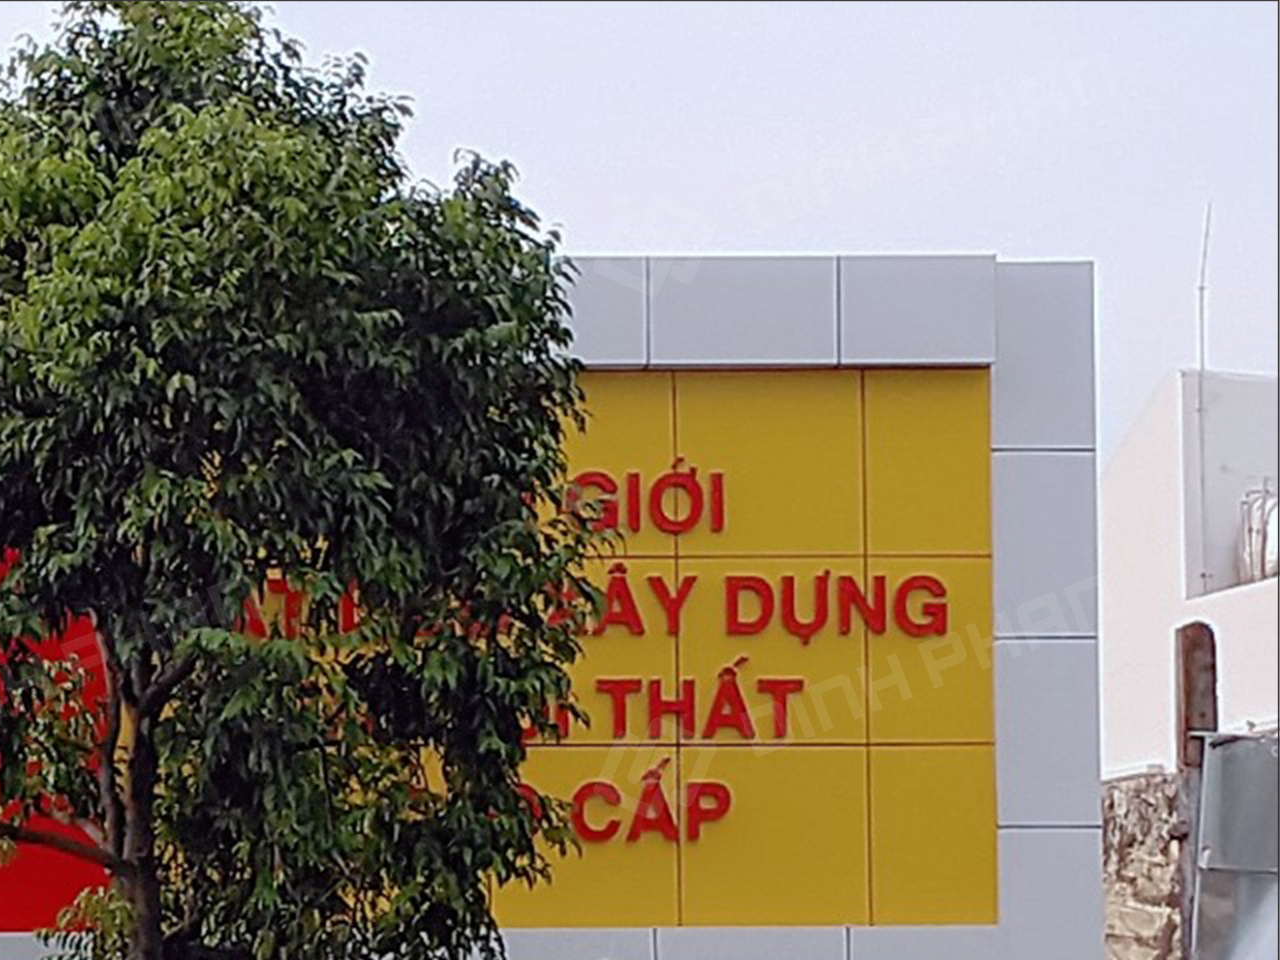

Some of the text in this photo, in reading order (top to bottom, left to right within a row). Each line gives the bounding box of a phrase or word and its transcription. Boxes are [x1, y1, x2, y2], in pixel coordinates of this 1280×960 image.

[566, 457, 725, 534] GIỚI
[724, 569, 950, 646] DỰNG
[595, 656, 804, 739] THẤT
[572, 757, 732, 844] CẤP
